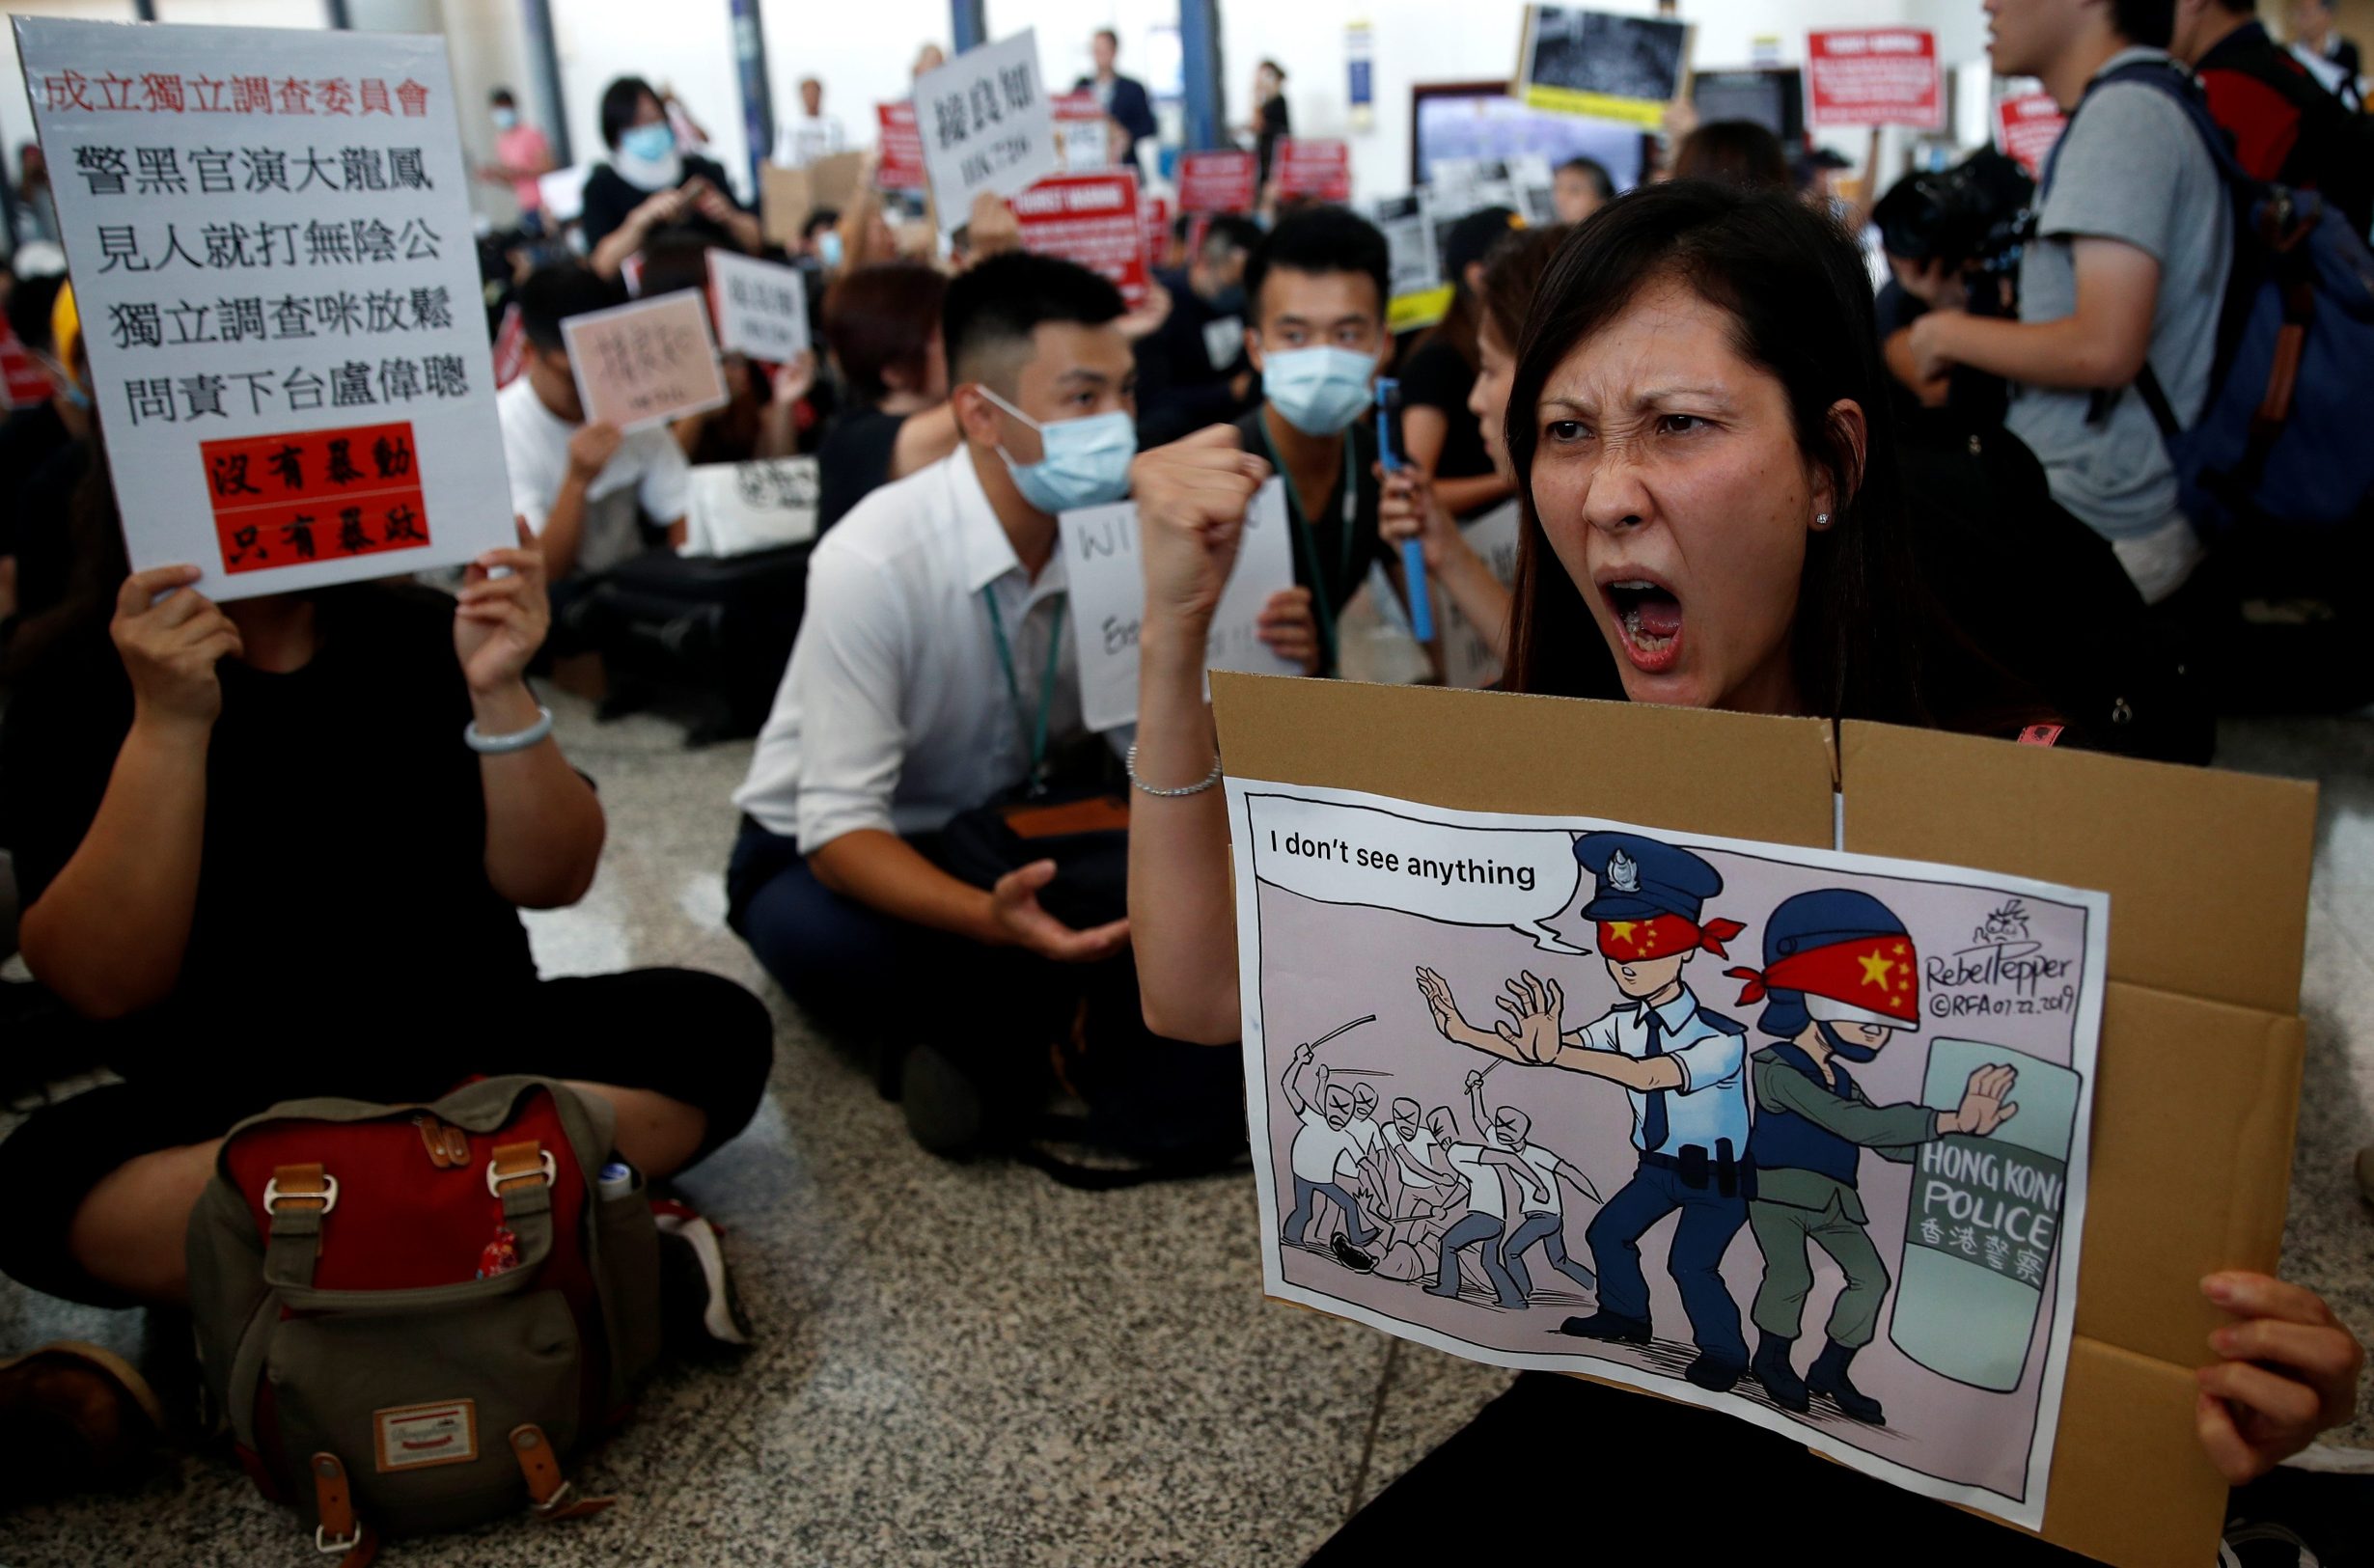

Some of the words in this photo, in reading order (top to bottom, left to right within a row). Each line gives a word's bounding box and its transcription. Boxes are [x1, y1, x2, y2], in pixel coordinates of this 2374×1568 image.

[43, 69, 430, 117] 成立獨立調查委員會
[73, 146, 434, 196] 警黑官演大龍鳳
[97, 217, 441, 274] 見人就打無陰公
[107, 285, 454, 350] 獨立調查咪放鬆
[124, 352, 471, 426] 問責下台盧偉聰
[229, 504, 427, 564] 只有暴政
[1270, 830, 1278, 852] I
[1285, 832, 1349, 864] don't
[1356, 847, 1399, 872] see
[1407, 857, 1536, 892] anything
[1922, 1141, 2000, 1193] HONG
[1923, 1180, 2055, 1252] POLICE
[1919, 1217, 2045, 1285] 香港警察
